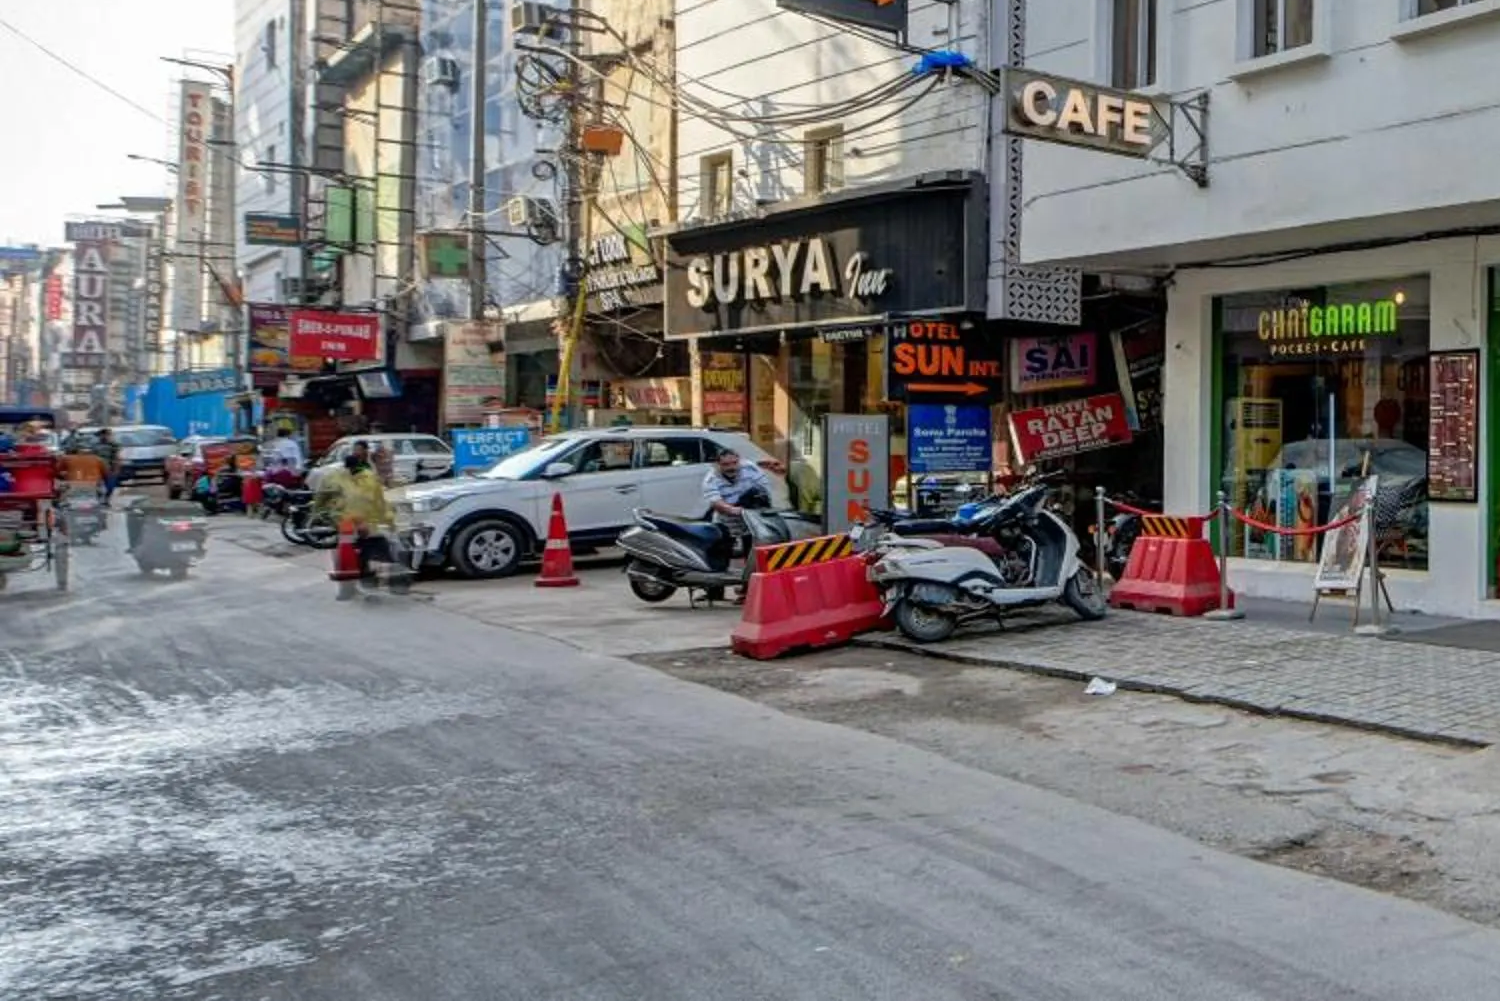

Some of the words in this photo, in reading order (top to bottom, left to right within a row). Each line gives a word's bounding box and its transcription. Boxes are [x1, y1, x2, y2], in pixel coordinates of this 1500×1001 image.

[1022, 79, 1154, 147] CAFE
[184, 93, 203, 214] TOURIST
[687, 238, 836, 308] SURYA
[845, 250, 893, 299] Inn
[77, 248, 108, 353] AURA
[893, 322, 960, 339] HOTEL
[894, 342, 965, 376] SUN
[969, 360, 1000, 376] INT.
[1025, 343, 1089, 373] SAI
[1269, 342, 1319, 356] POCKET
[1331, 340, 1366, 352] CAFE
[1027, 404, 1113, 435] RATAN
[1044, 400, 1090, 415] HOTEL
[457, 430, 525, 444] PERFECT
[833, 421, 881, 435] HOTEL
[1041, 422, 1108, 448] DEEP
[471, 443, 512, 456] LOOK
